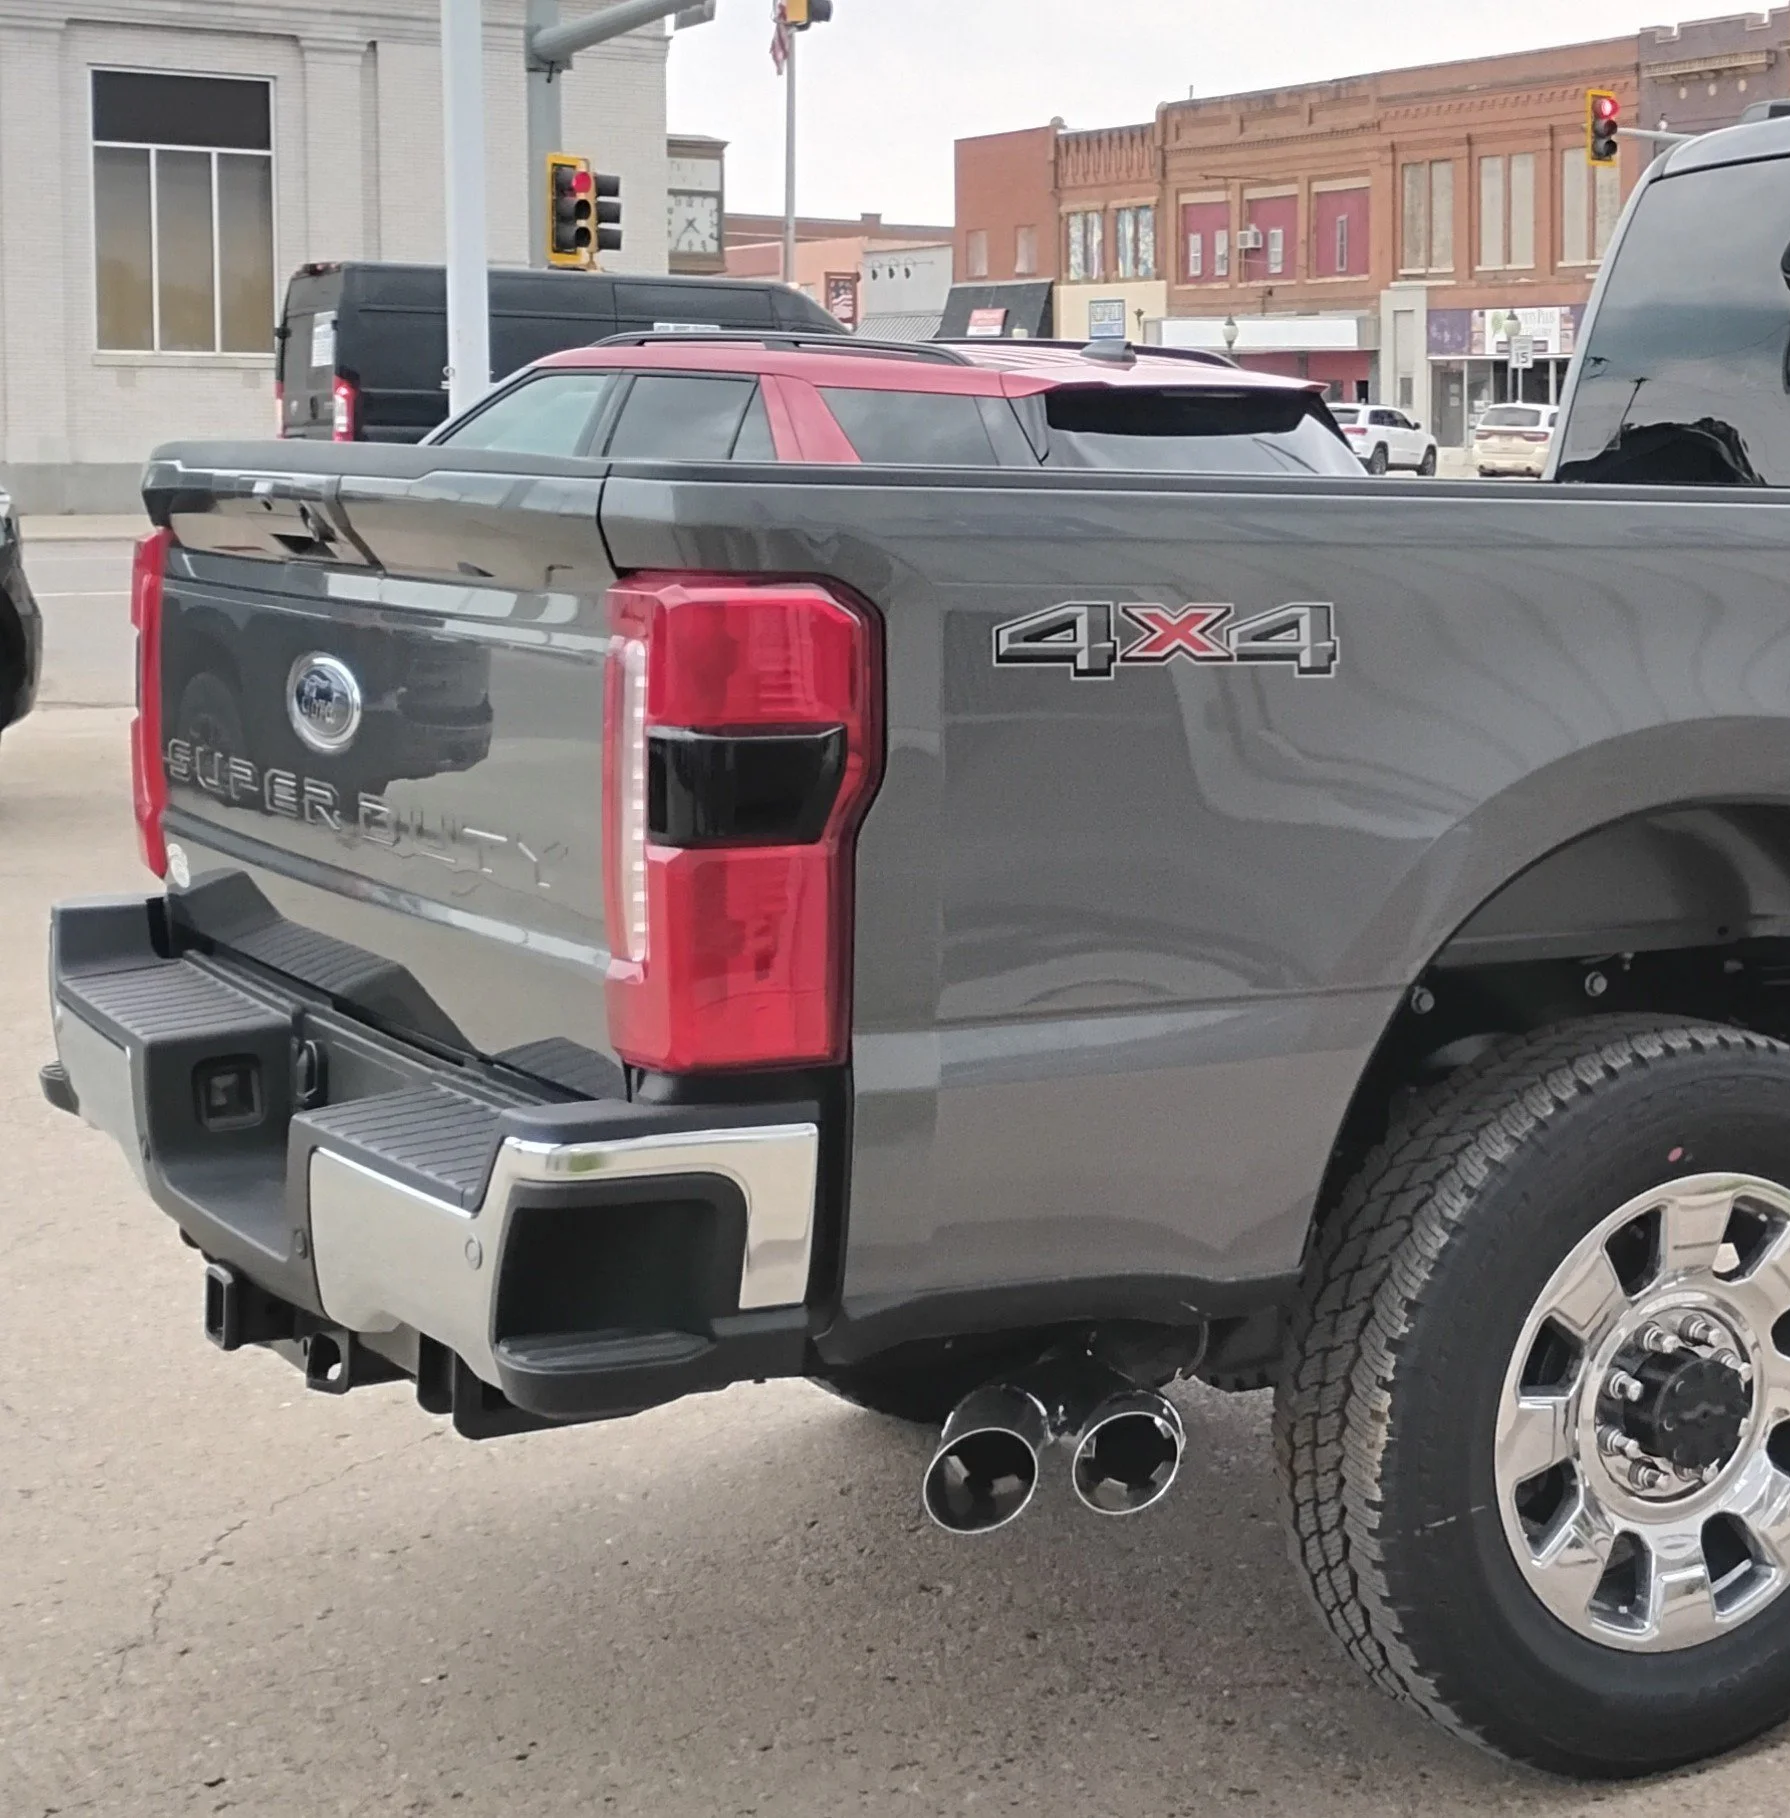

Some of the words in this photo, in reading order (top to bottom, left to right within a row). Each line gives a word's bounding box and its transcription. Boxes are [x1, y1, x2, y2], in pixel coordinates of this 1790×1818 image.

[1515, 351, 1529, 364] 15
[301, 674, 340, 725] Ford
[164, 737, 343, 833] SUPER
[357, 791, 570, 889] DUTY
